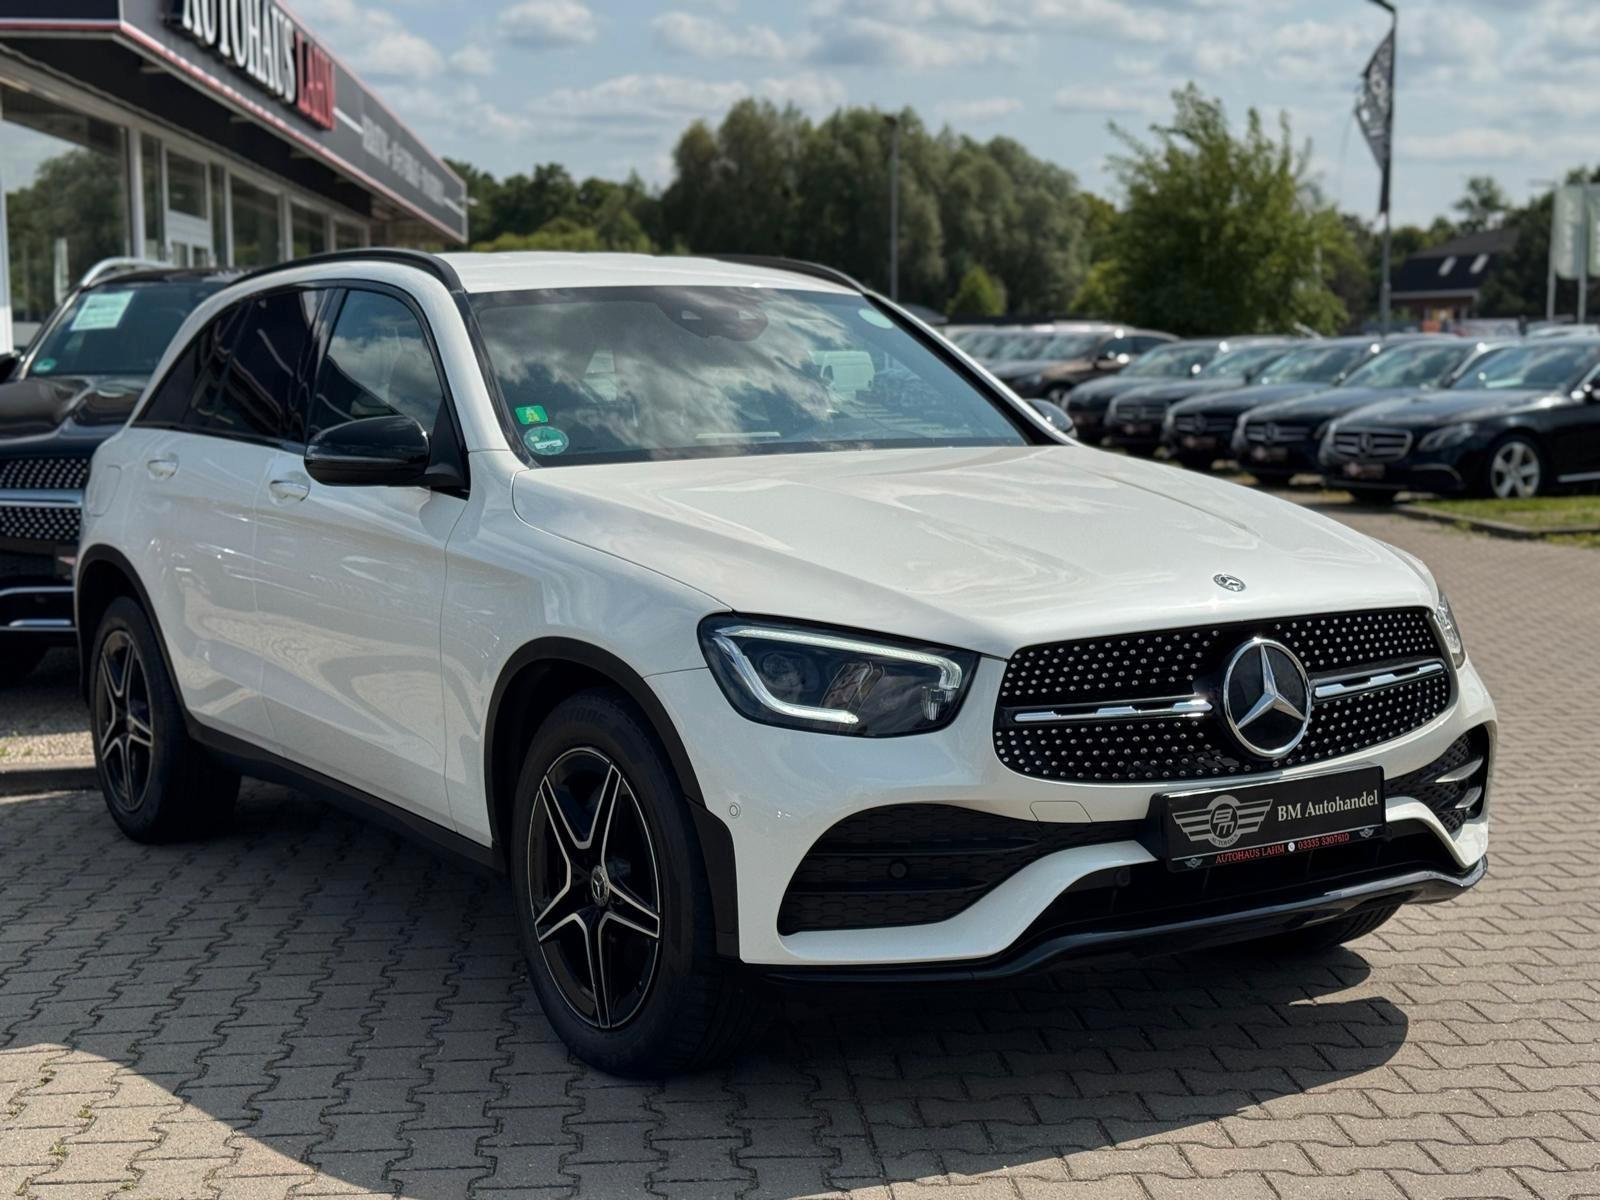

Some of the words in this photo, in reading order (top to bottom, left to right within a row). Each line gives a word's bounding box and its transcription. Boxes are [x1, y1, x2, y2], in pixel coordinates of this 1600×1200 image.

[183, 0, 296, 103] OHAUS
[1277, 803, 1302, 822] BM
[1306, 790, 1378, 817] Autohandel
[1215, 848, 1260, 864] AUTOHAUS
[1261, 844, 1285, 857] LAHM
